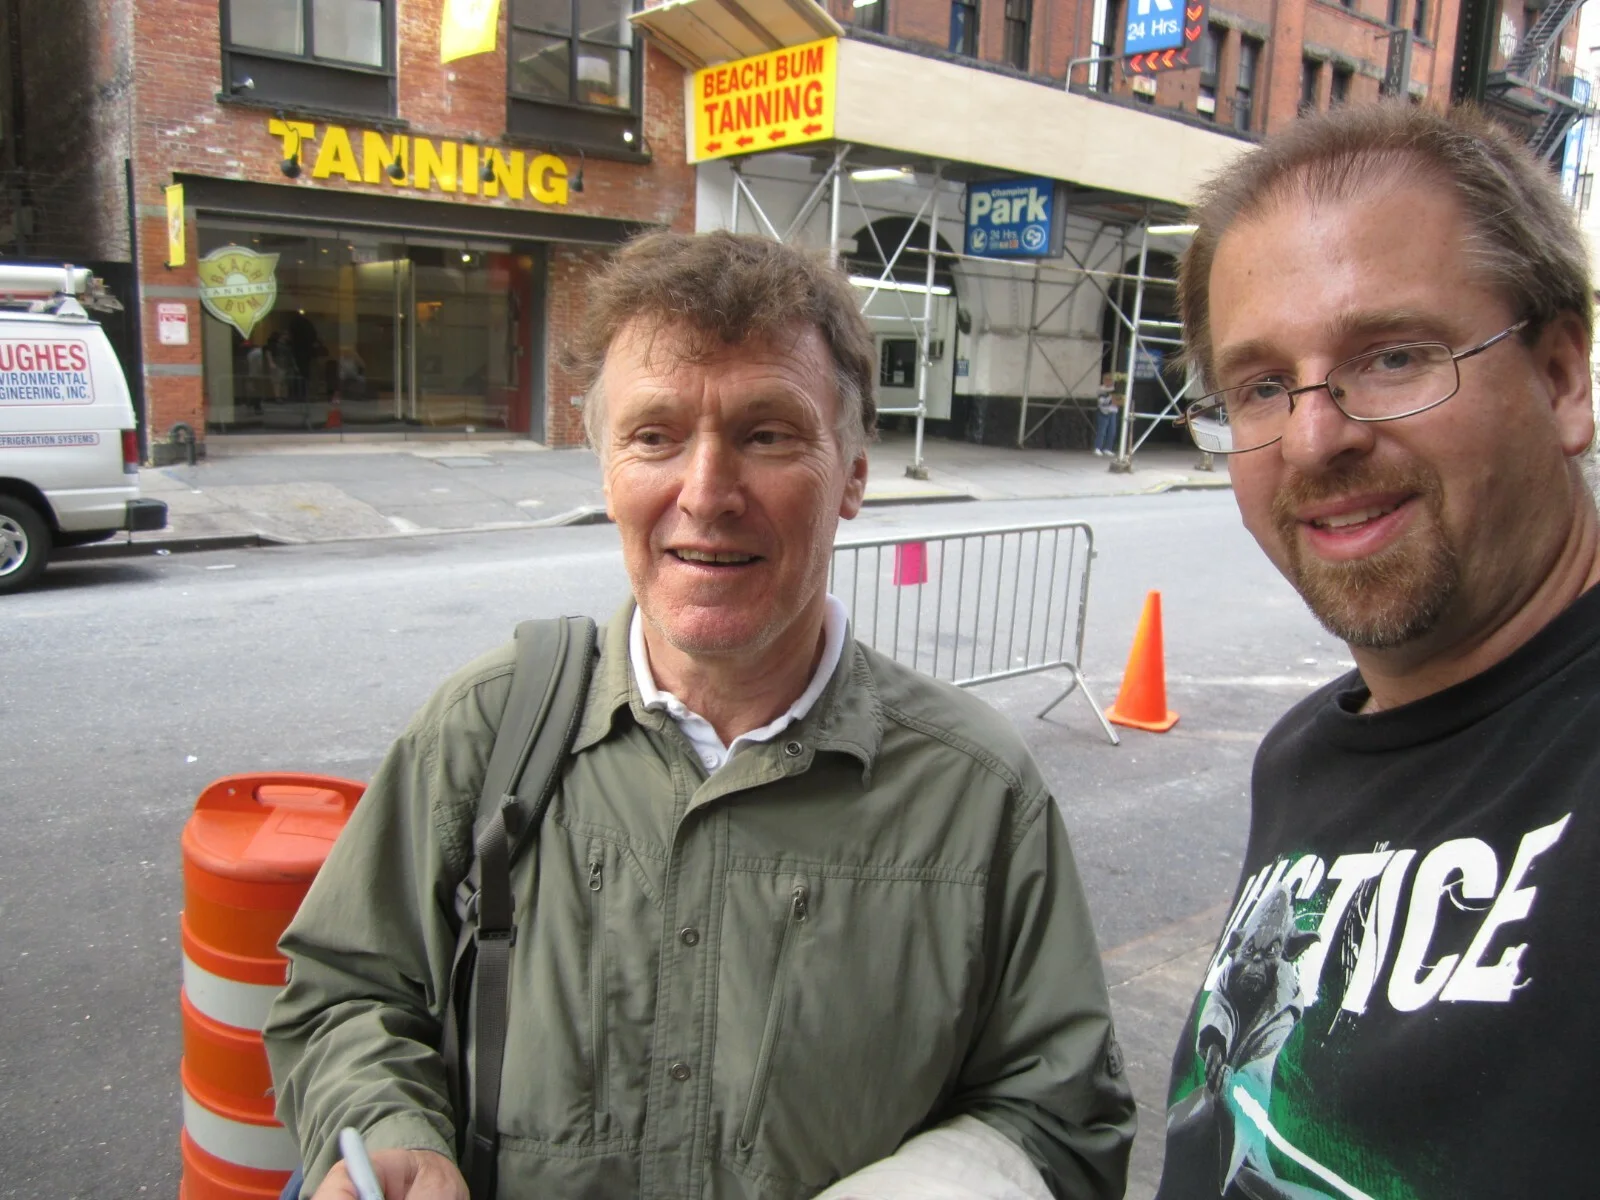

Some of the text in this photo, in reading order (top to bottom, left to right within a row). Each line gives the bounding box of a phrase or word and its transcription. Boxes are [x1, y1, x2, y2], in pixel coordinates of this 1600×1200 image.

[1127, 21, 1145, 41] 24
[703, 46, 824, 99] BEACH BUM
[703, 80, 823, 136] TANNING
[268, 118, 569, 205] TANNING
[969, 187, 1048, 226] Park
[210, 258, 264, 285] BEACH
[201, 284, 275, 297] TANNING
[225, 296, 261, 314] BUM
[0, 344, 87, 372] UGHES
[66, 385, 91, 399] INC.
[57, 434, 95, 444] SYSTEMS
